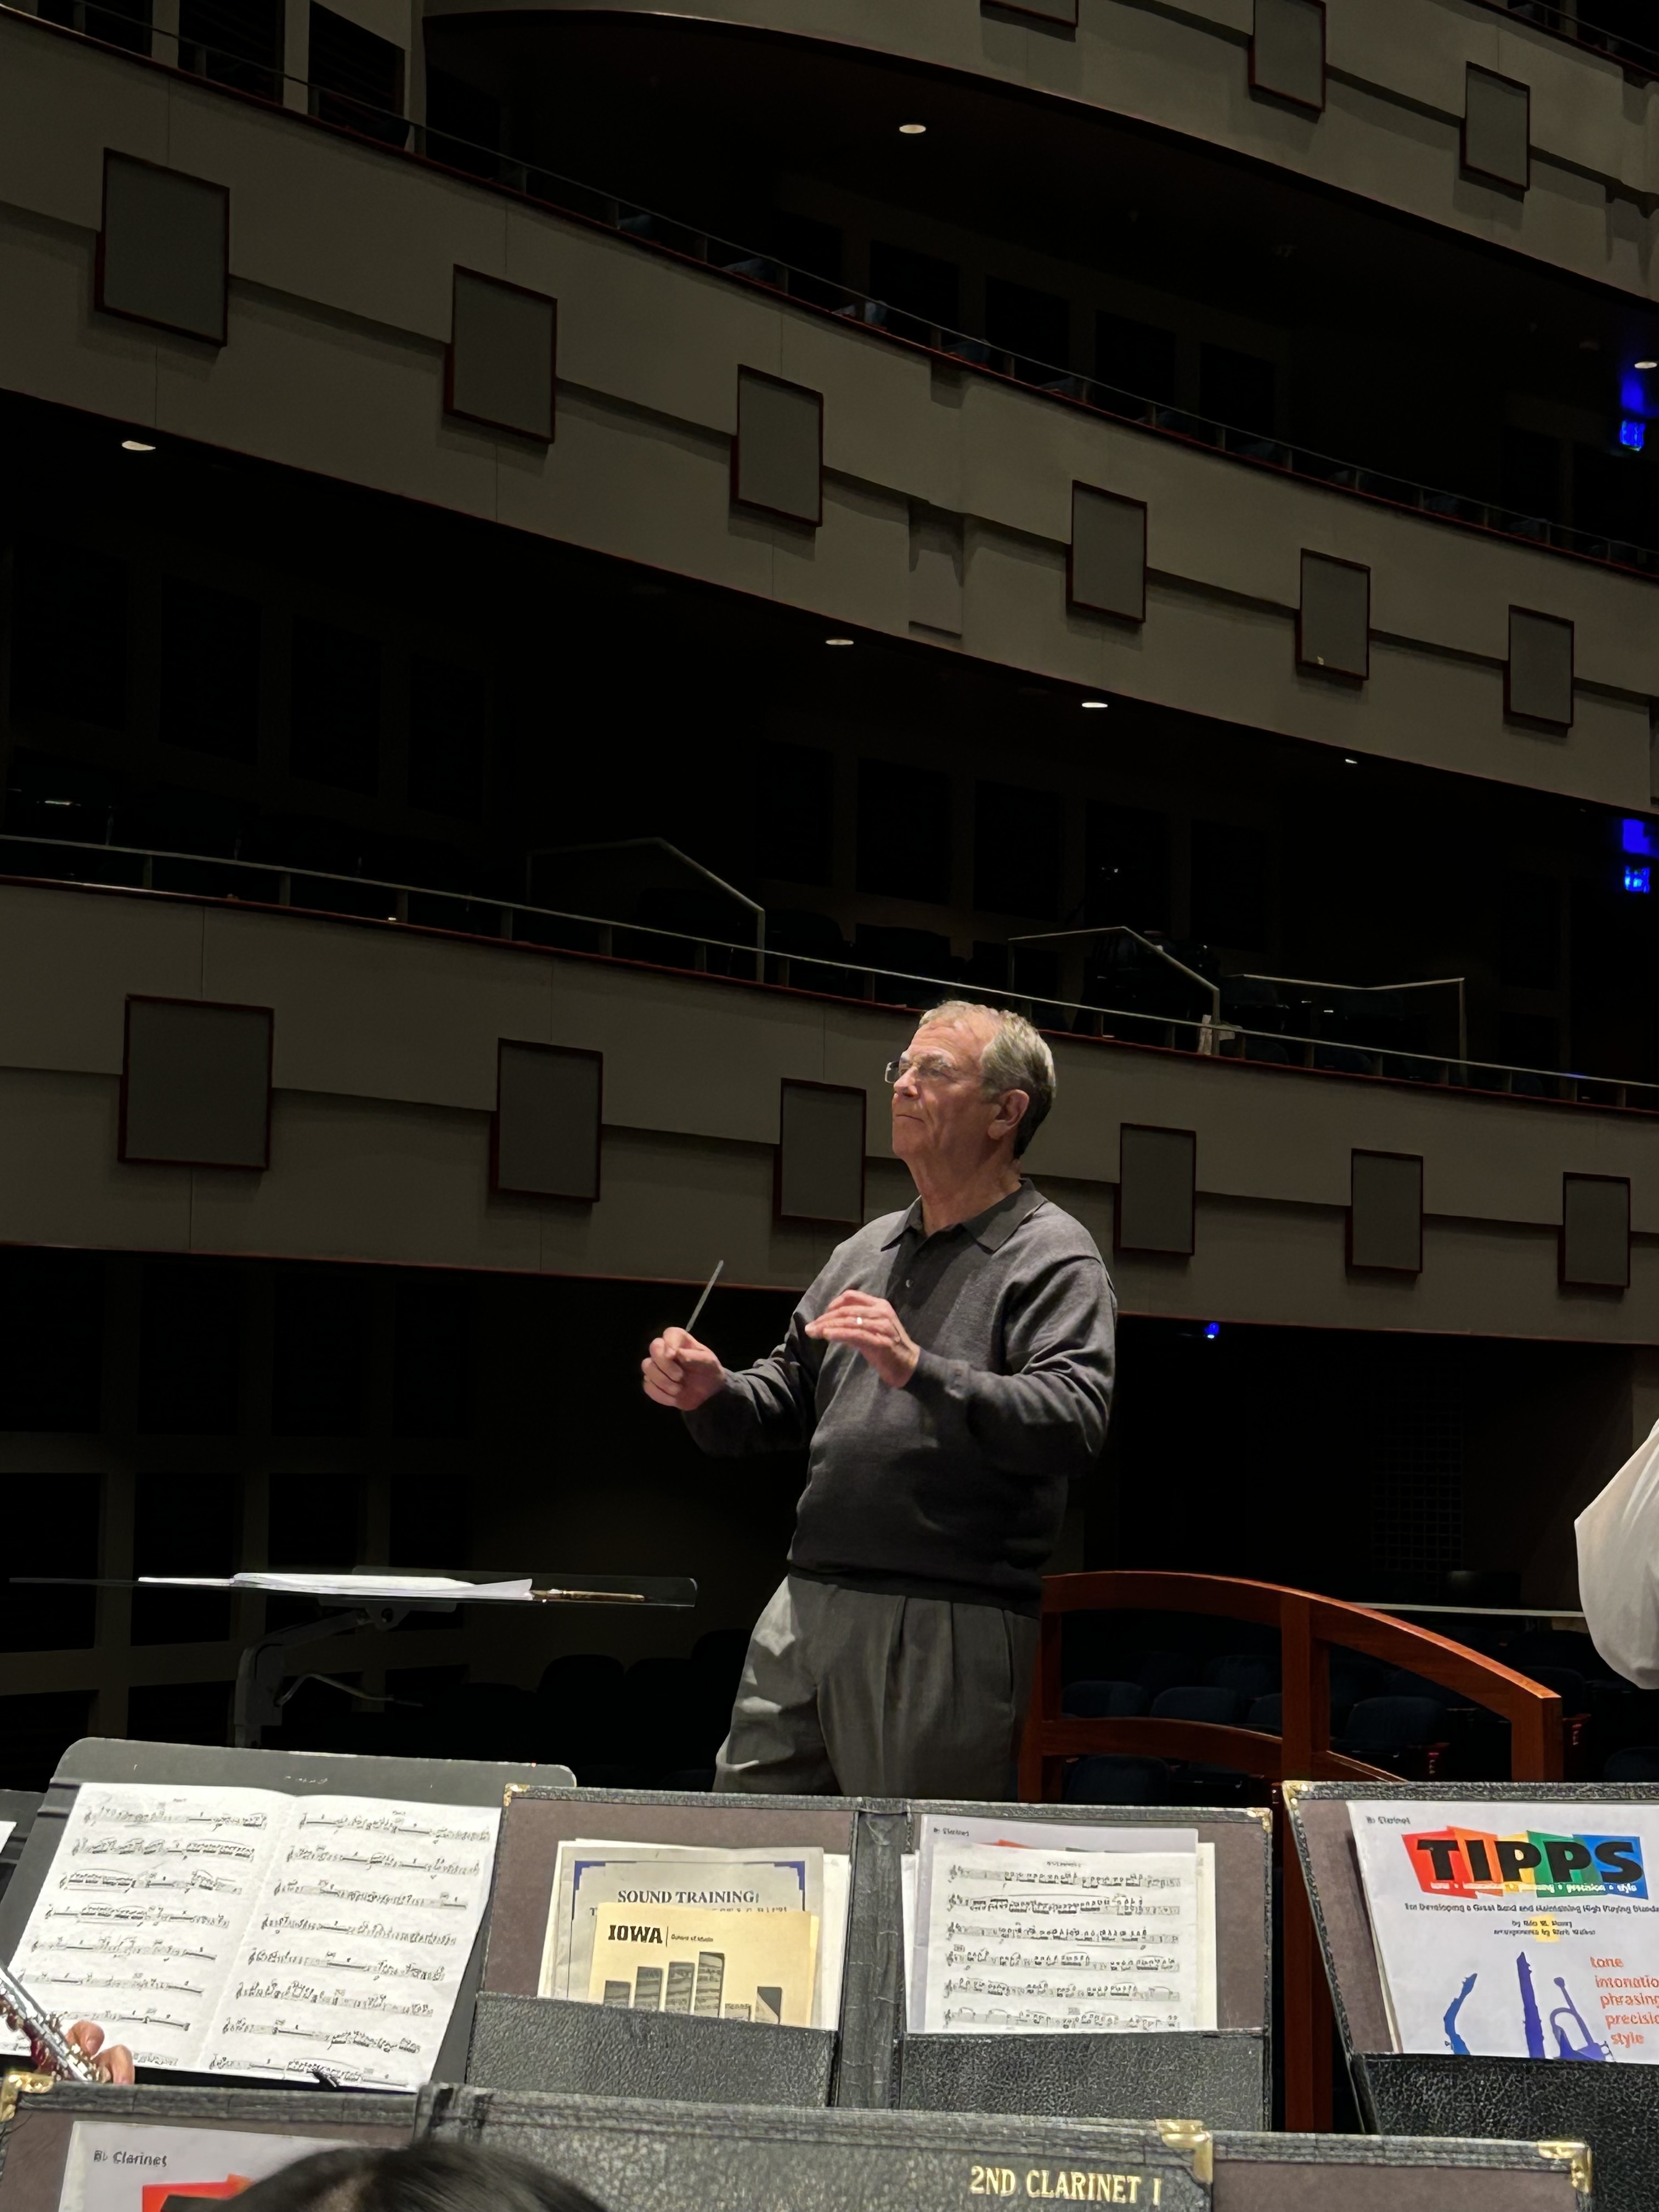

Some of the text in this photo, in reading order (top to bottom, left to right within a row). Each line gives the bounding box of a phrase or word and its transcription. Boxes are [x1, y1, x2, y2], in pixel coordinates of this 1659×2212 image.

[1417, 1839, 1643, 1883] TIPPS
[618, 1890, 672, 1904] SOUND
[608, 1925, 663, 1944] IOWA
[1590, 1956, 1624, 1968] tone
[1611, 2032, 1644, 2048] style
[970, 2165, 1017, 2197] 2ND
[1026, 2169, 1142, 2204] CLARINET
